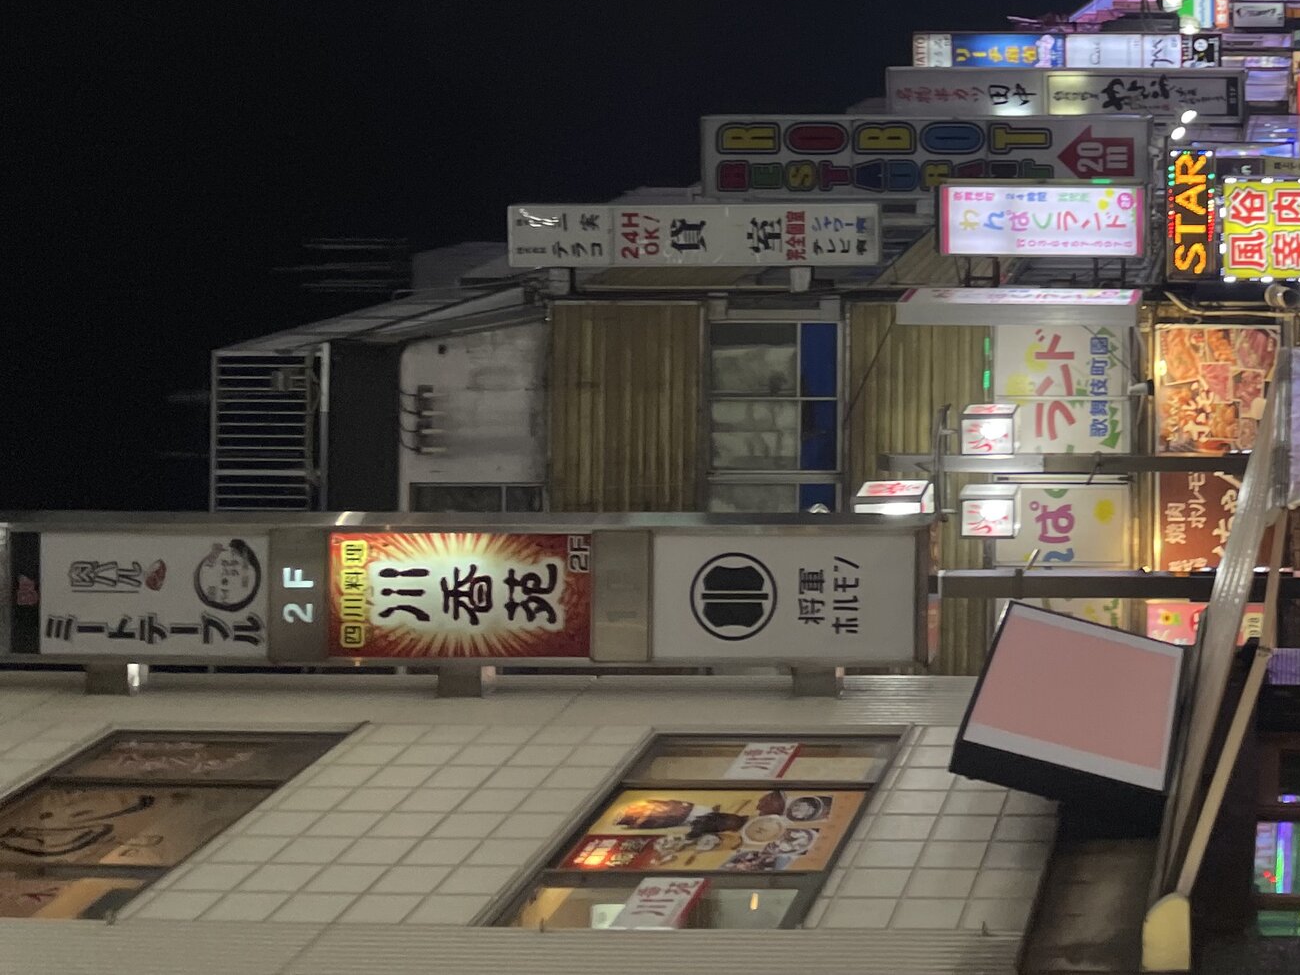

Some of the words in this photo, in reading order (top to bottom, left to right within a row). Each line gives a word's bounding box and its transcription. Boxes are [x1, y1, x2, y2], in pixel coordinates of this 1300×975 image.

[714, 121, 1053, 155] ROBOT
[1076, 142, 1104, 172] 20
[714, 158, 1054, 193] RESTAURANT
[620, 211, 640, 260] 24H
[642, 215, 661, 256] OK!
[785, 210, 807, 261] 完全個室
[958, 208, 1127, 232] わんぱくランド
[1174, 153, 1207, 275] STAR
[1229, 187, 1268, 271] 風俗
[1164, 502, 1187, 544] 焼肉
[1185, 471, 1208, 529] ホルモ
[570, 535, 590, 572] 2F
[282, 567, 314, 623] 2F
[343, 543, 364, 645] 四川料理
[377, 563, 558, 626] 川香苑
[797, 567, 826, 625] 将軍
[831, 555, 860, 634] ホルモン
